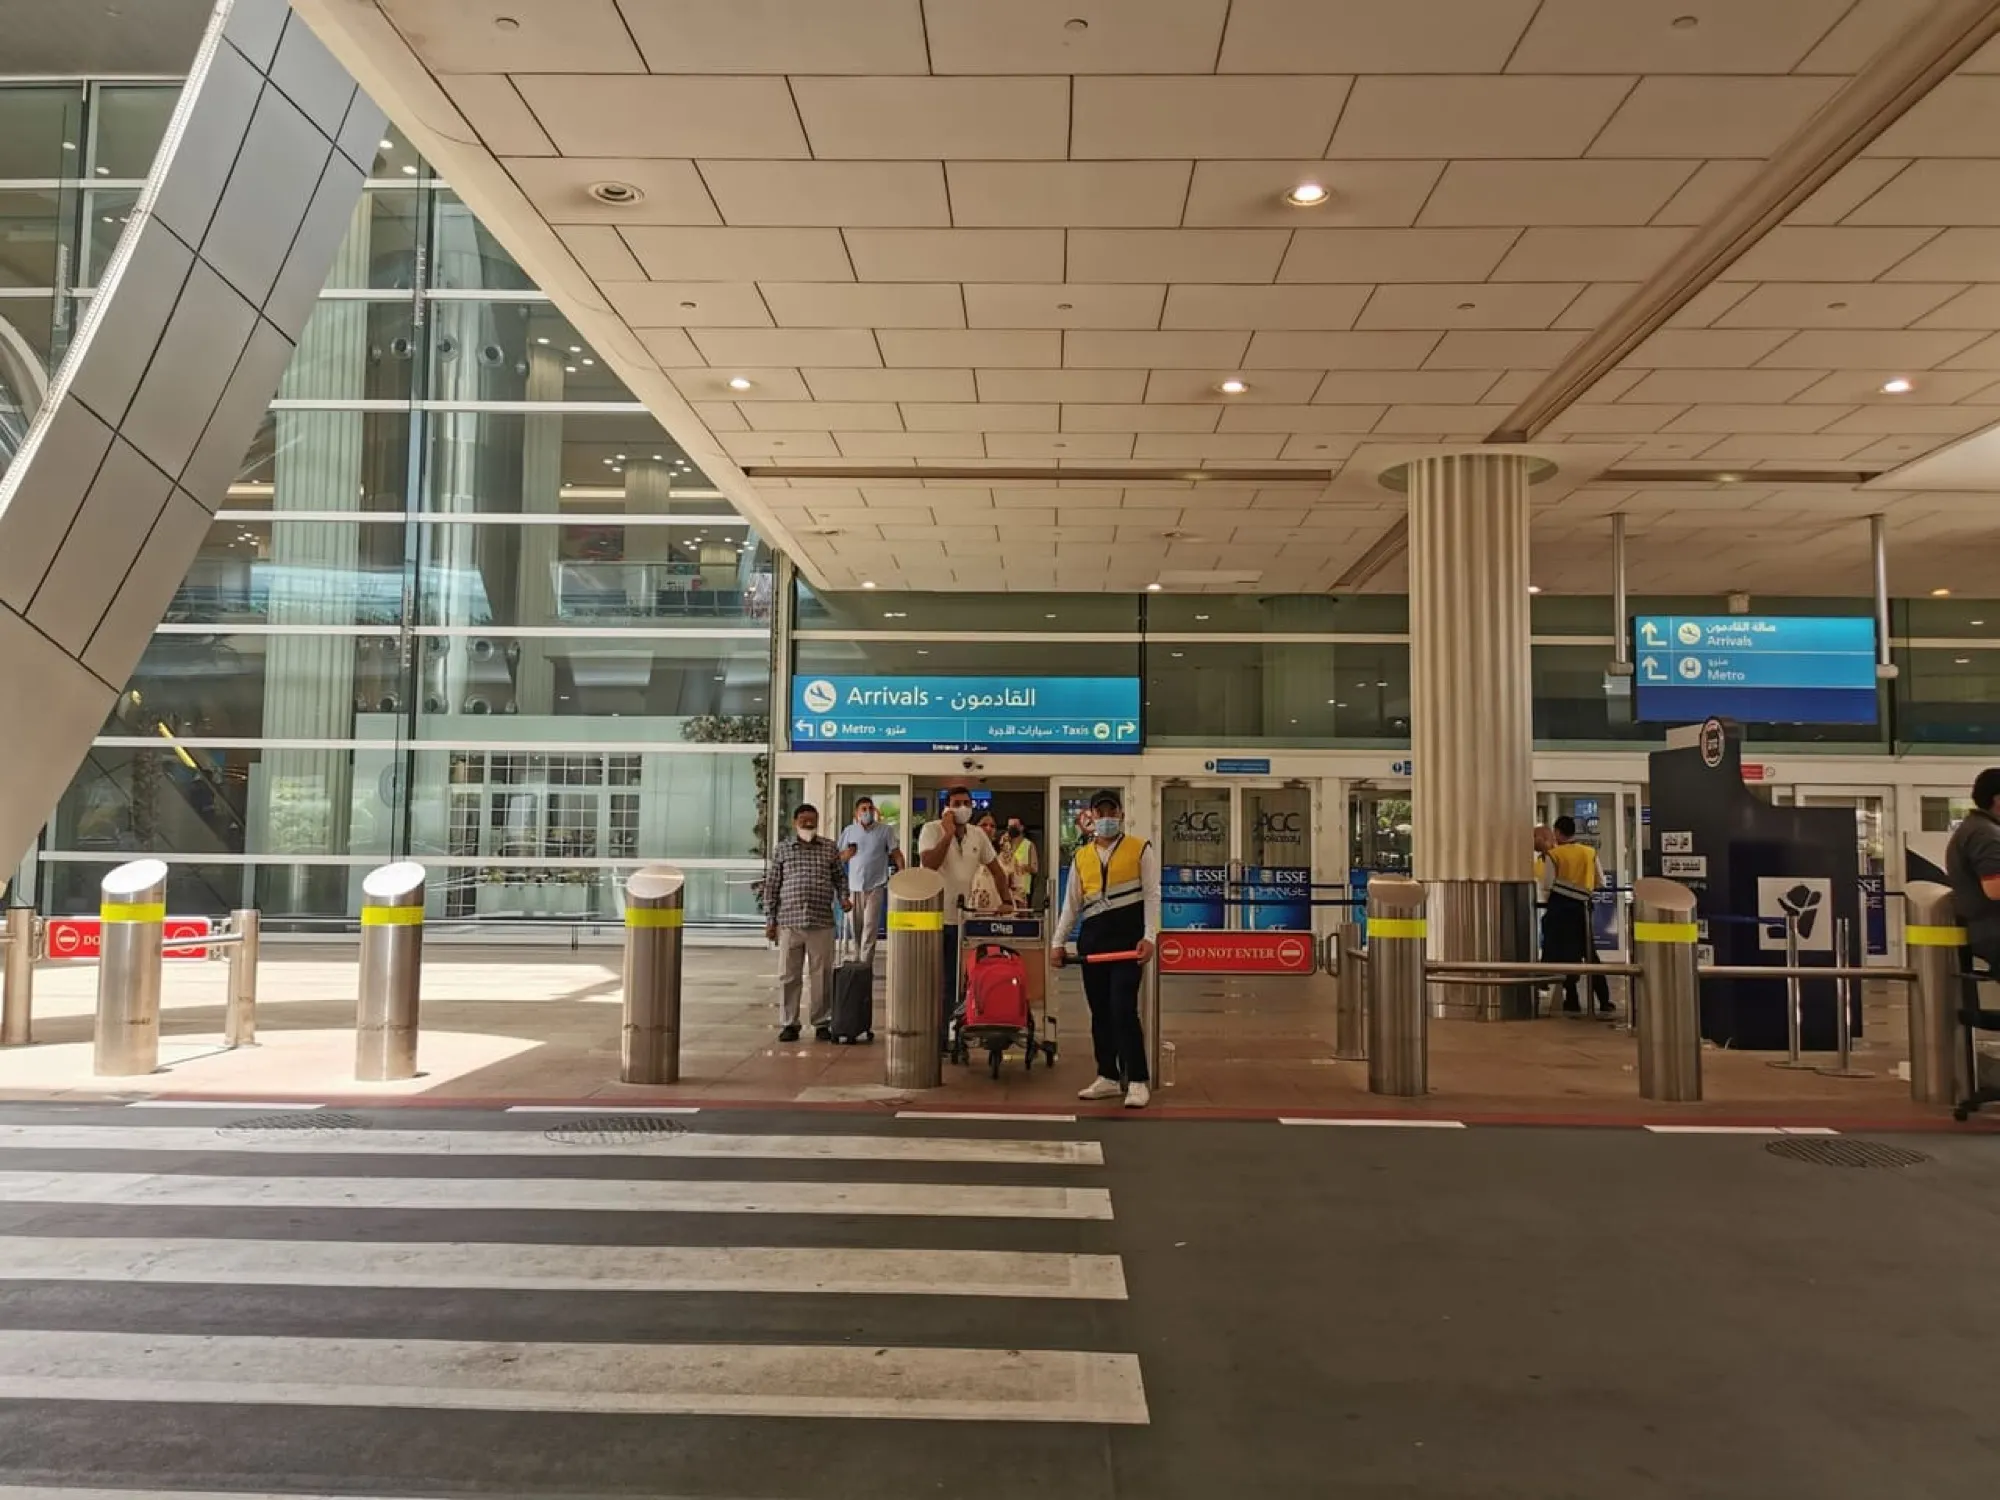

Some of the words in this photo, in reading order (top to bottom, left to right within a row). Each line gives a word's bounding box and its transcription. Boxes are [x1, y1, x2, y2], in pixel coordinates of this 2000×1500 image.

[1707, 635, 1752, 647] Arrivals
[1707, 670, 1745, 681] Metro
[846, 685, 929, 706] Arrivals
[950, 687, 1036, 710] القادمون
[842, 723, 876, 735] Metro
[1062, 724, 1089, 735] Taxis
[1275, 871, 1308, 884] ESSE
[83, 935, 101, 946] DO
[1187, 947, 1206, 959] DO
[1207, 947, 1233, 959] NOT
[1235, 947, 1276, 959] ENTER
